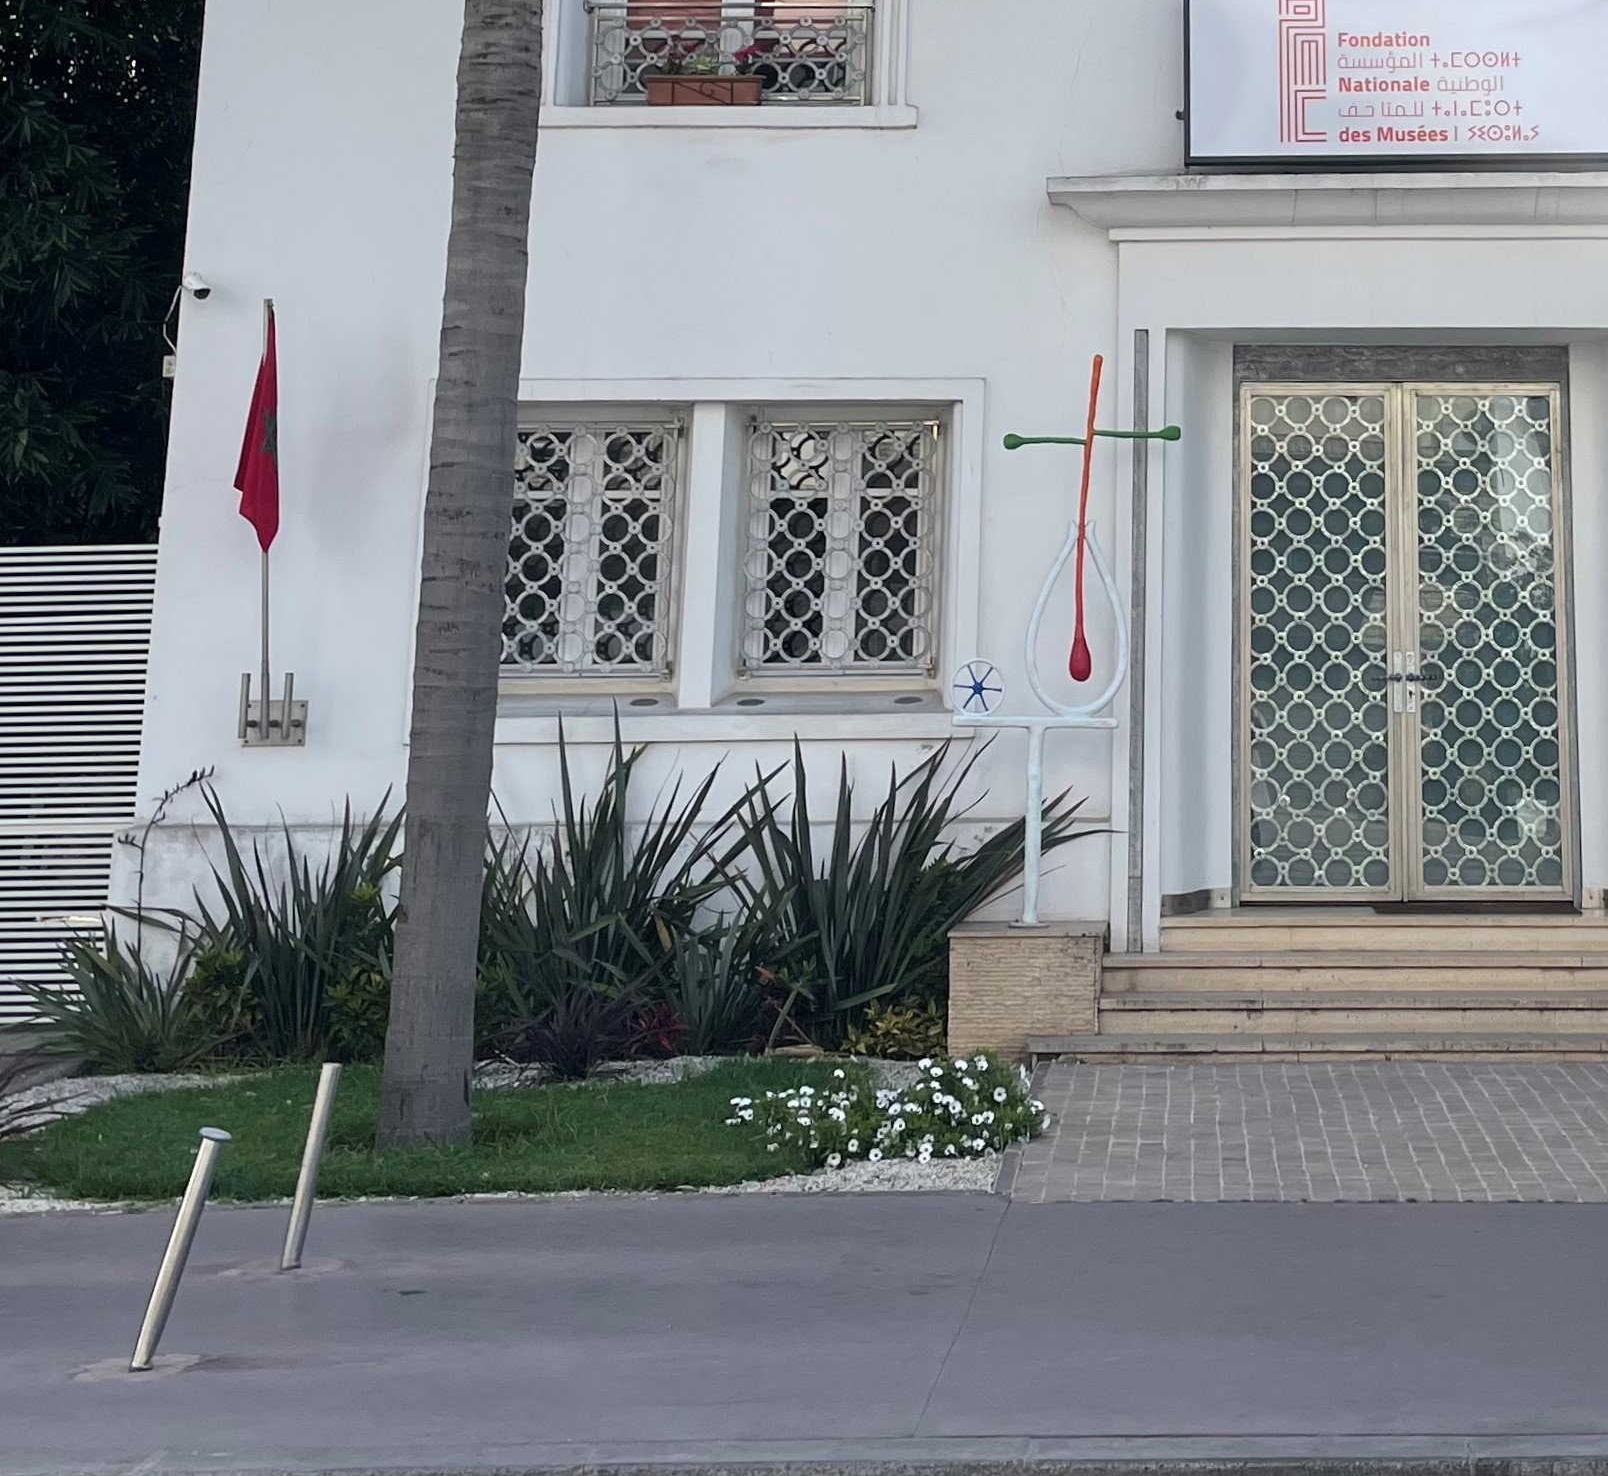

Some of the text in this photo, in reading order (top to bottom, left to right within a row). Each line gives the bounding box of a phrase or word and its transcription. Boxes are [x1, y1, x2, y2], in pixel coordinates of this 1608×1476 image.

[1337, 31, 1430, 48] Fondation
[1337, 50, 1423, 74] المؤسسة
[1338, 76, 1430, 93] Nationale
[1437, 75, 1504, 97] الوطنية
[1338, 124, 1449, 143] des Musées
